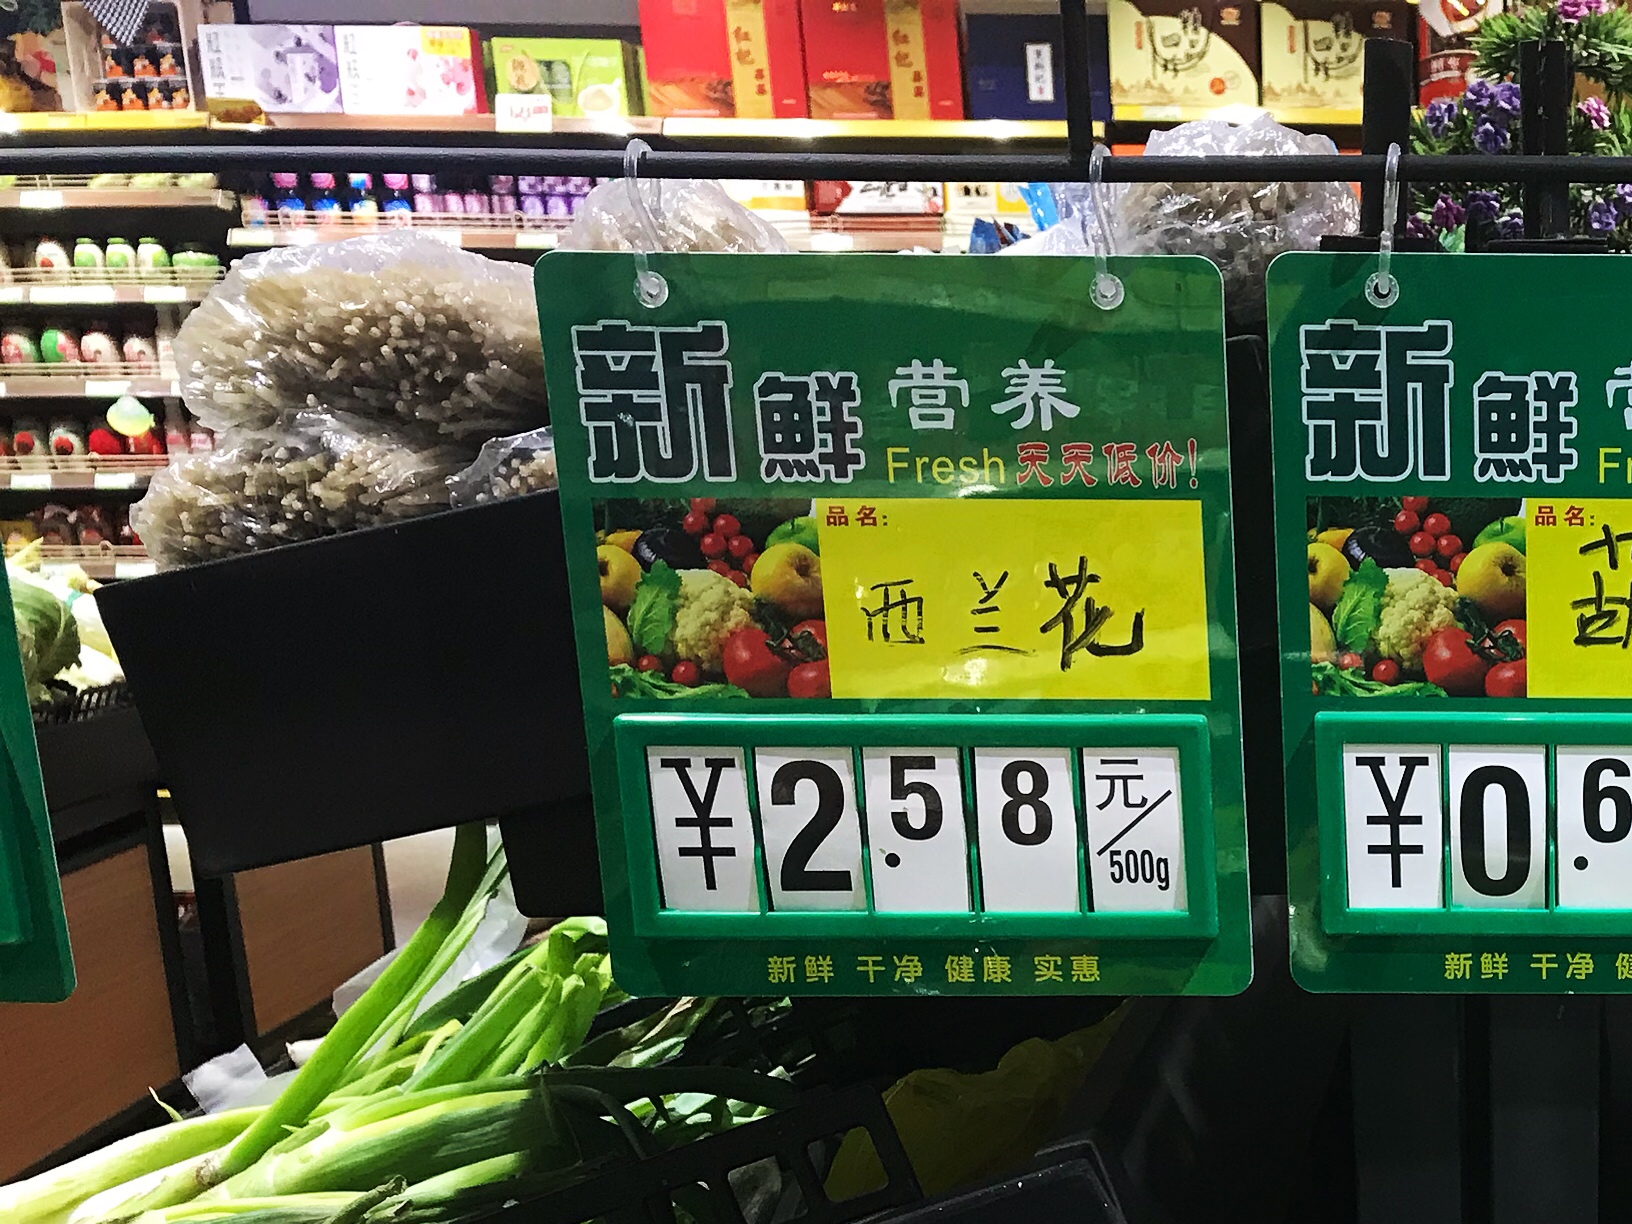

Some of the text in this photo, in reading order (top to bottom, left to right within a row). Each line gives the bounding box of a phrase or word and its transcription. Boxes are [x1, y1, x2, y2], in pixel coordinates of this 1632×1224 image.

[888, 358, 1080, 431] 营养
[888, 447, 1005, 484] Fresh
[861, 556, 1144, 672] 西兰花
[768, 955, 1101, 983] 新鲜 干净 健康 实惠
[1444, 953, 1509, 980] 新鲜
[1530, 953, 1595, 979] 干净
